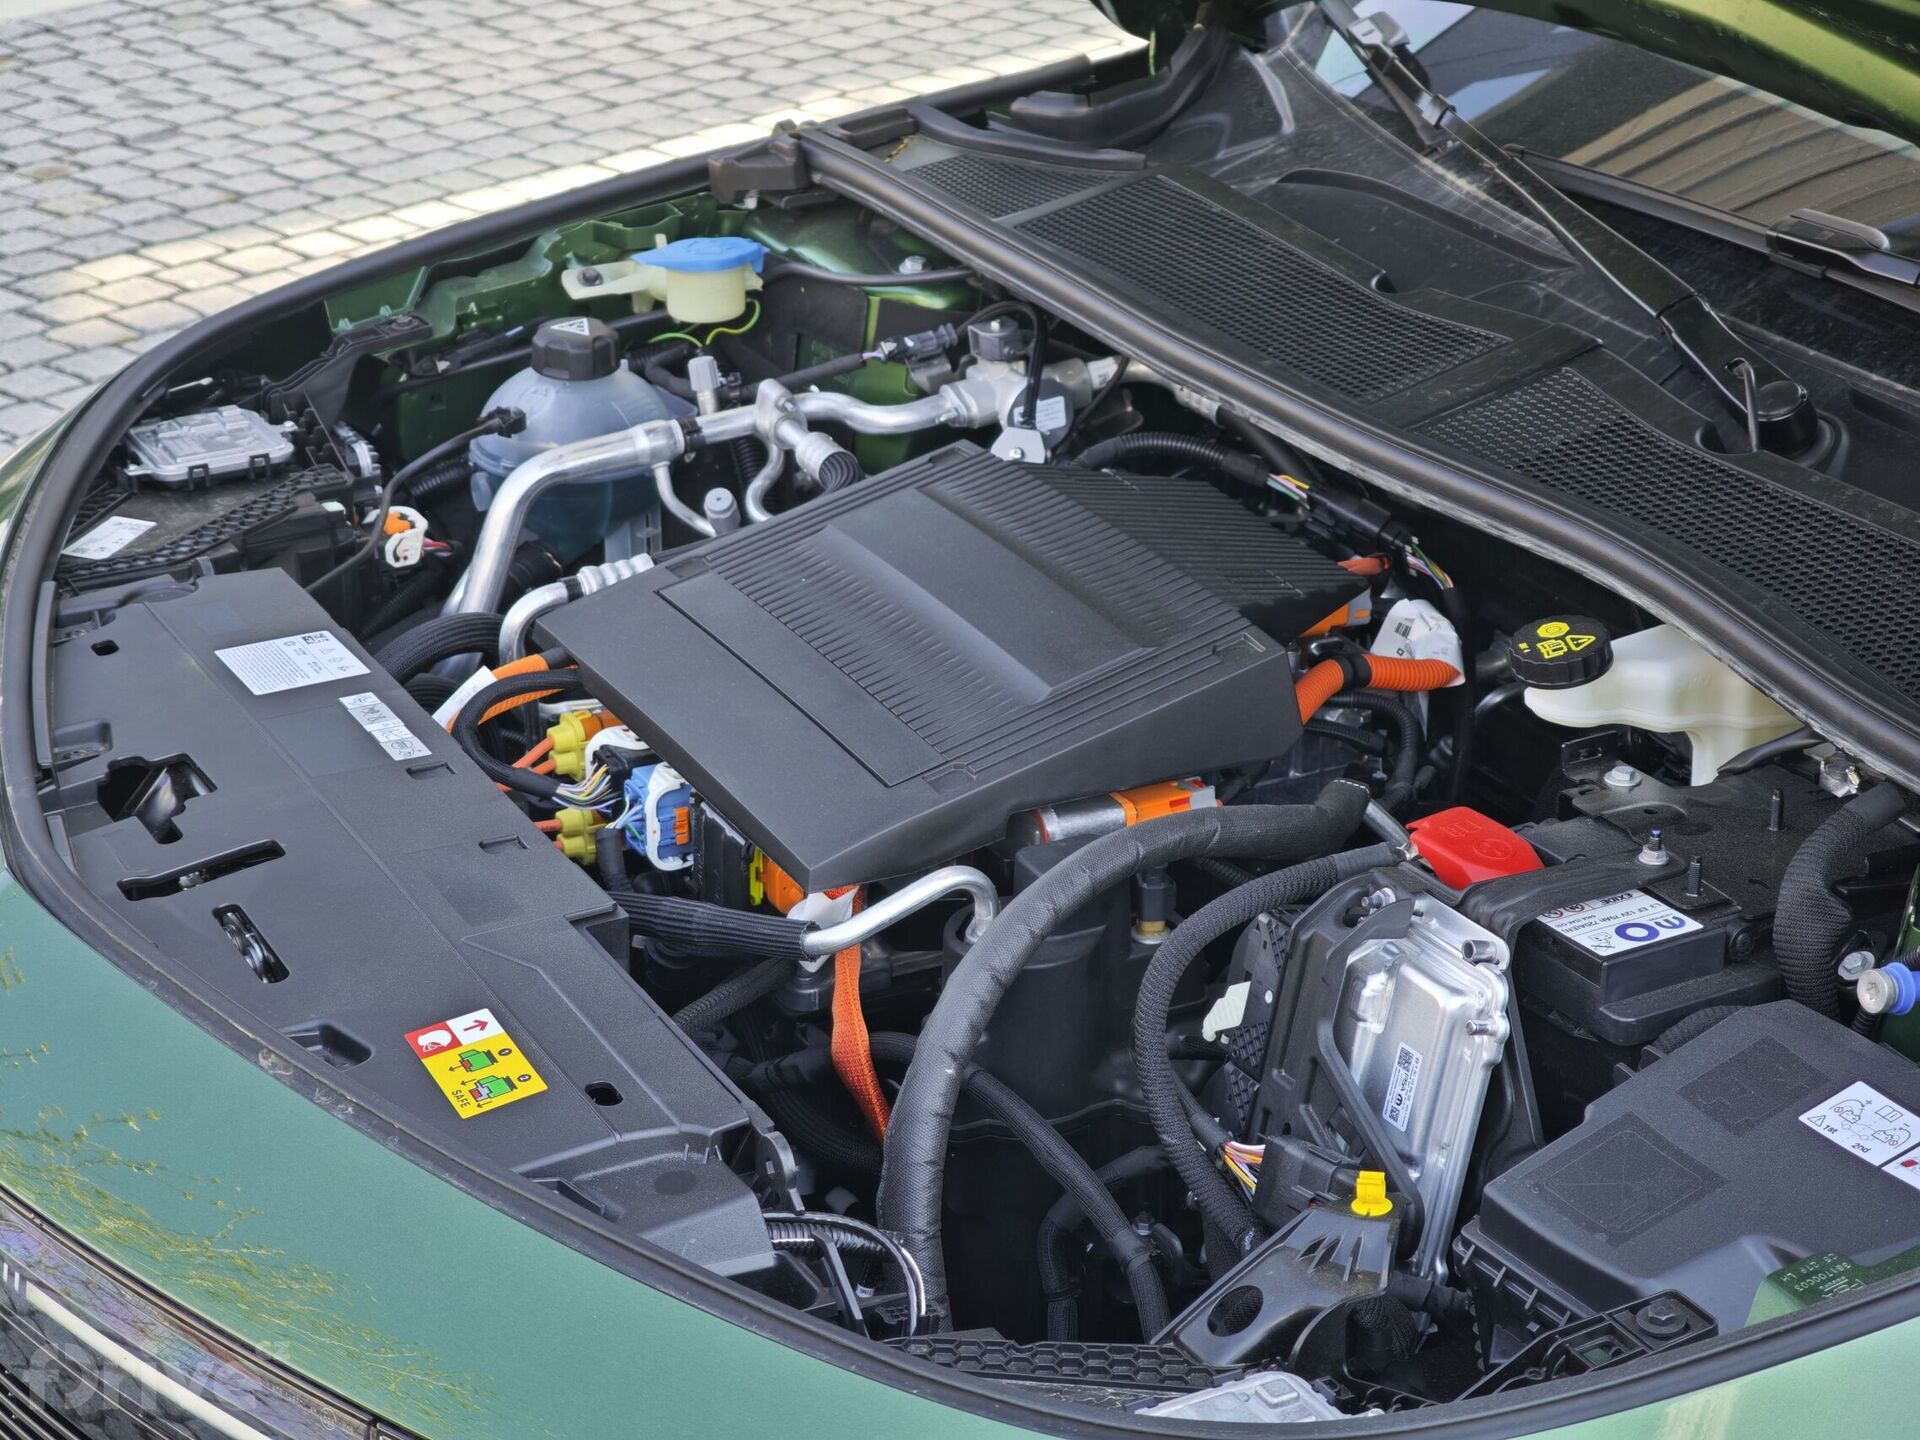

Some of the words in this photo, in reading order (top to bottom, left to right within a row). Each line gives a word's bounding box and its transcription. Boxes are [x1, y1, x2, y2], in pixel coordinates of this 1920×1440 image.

[1600, 892, 1633, 904] EXIDE
[451, 1089, 471, 1108] SAFE
[1822, 1124, 1838, 1134] 1st
[1851, 1142, 1872, 1153] 2nd
